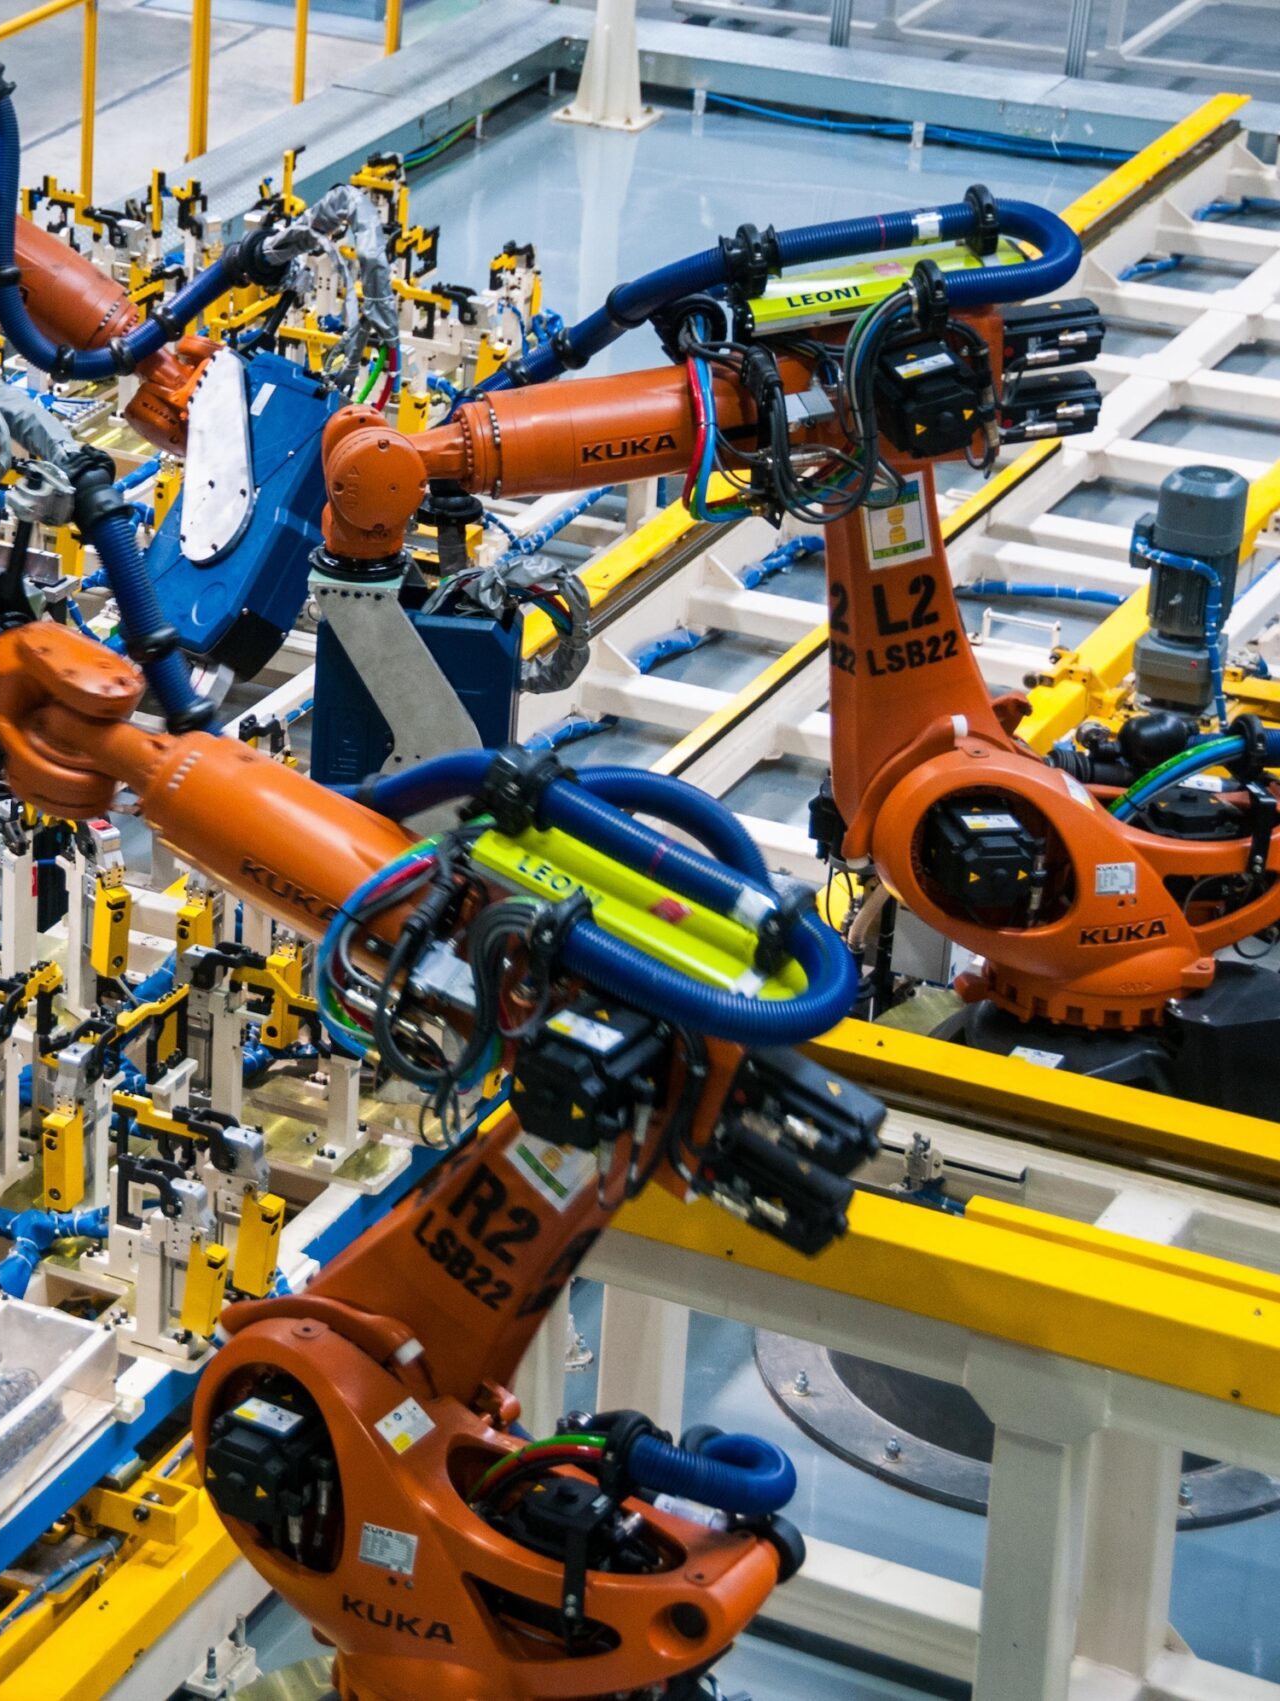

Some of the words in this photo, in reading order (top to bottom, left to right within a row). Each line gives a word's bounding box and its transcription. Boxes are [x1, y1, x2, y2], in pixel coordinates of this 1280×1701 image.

[786, 285, 861, 308] LEONI
[581, 433, 677, 463] KUKA
[872, 574, 939, 636] L2
[866, 630, 959, 677] LSB22
[1079, 920, 1168, 945] KUKA
[448, 1163, 540, 1266] R2
[413, 1210, 513, 1311] LSB22
[363, 1525, 394, 1538] KUKA
[342, 1593, 454, 1645] KUKA
